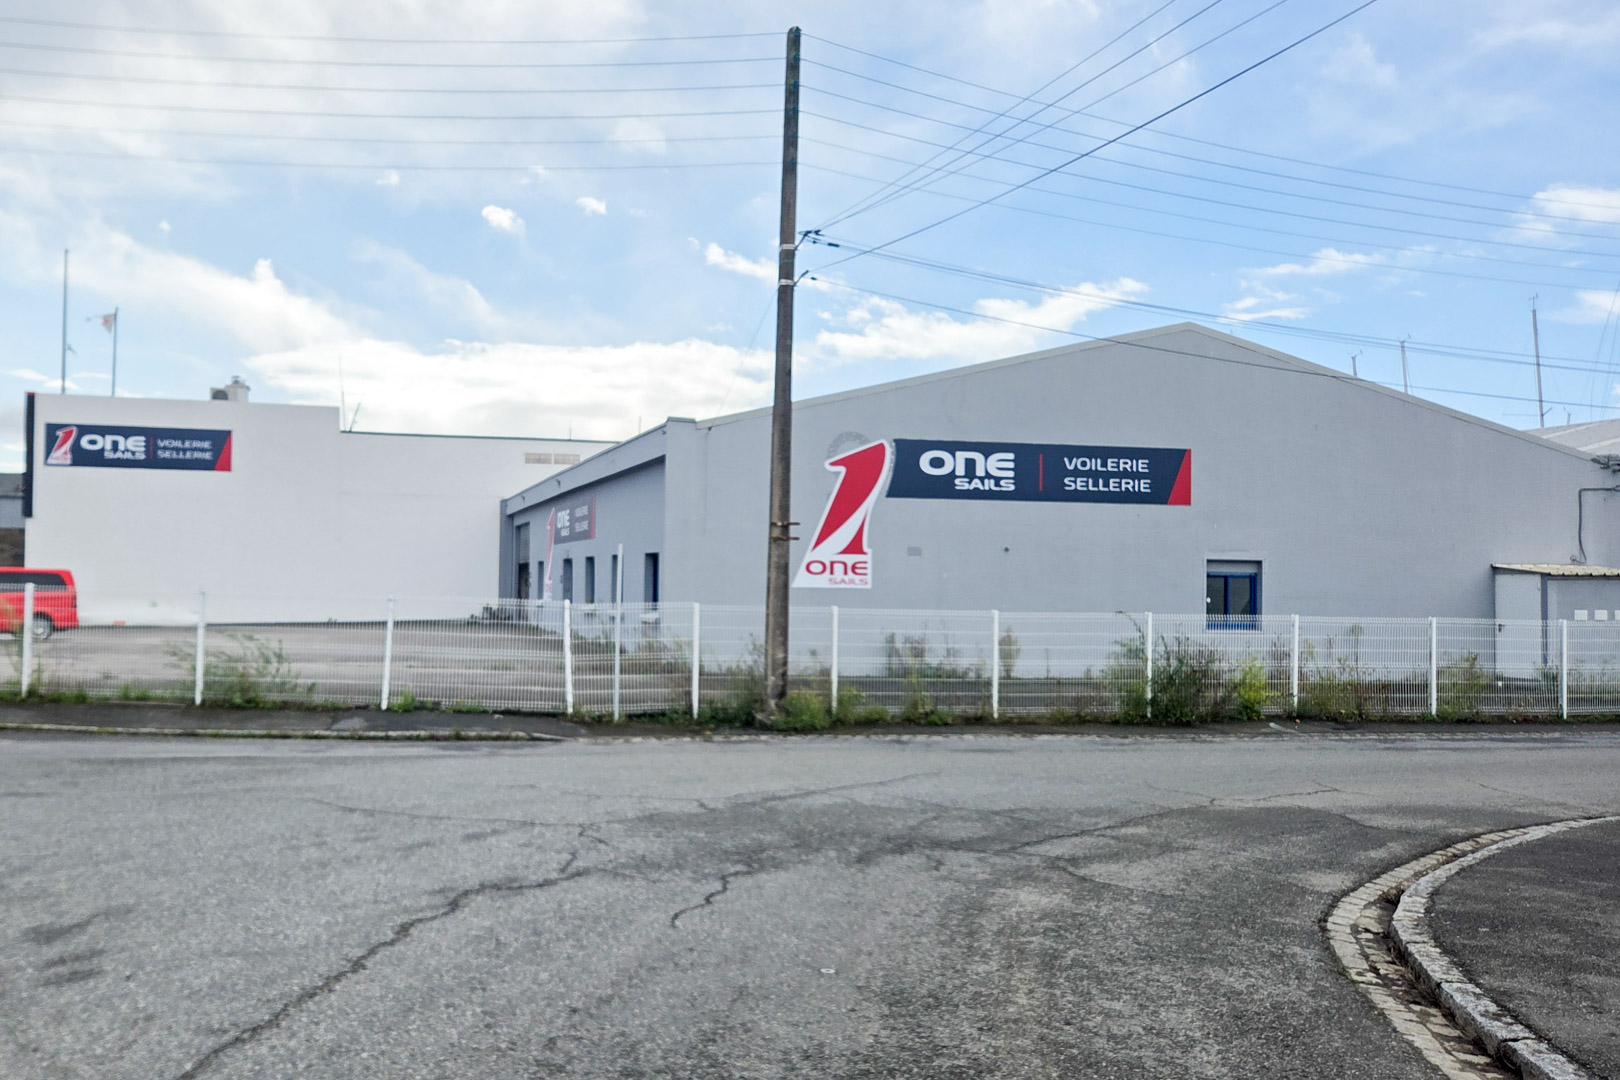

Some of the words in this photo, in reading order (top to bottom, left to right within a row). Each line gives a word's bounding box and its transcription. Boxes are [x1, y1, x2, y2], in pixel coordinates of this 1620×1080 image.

[157, 439, 212, 449] VOILERIE
[104, 452, 146, 460] SAILS
[157, 450, 213, 461] SELLERIE
[919, 450, 1015, 477] ONE
[1063, 456, 1149, 473] VOILERIE
[954, 478, 1016, 491] SAILS
[1063, 477, 1151, 493] SELLERIE
[806, 560, 868, 576] ONE
[828, 578, 868, 586] SAILS
